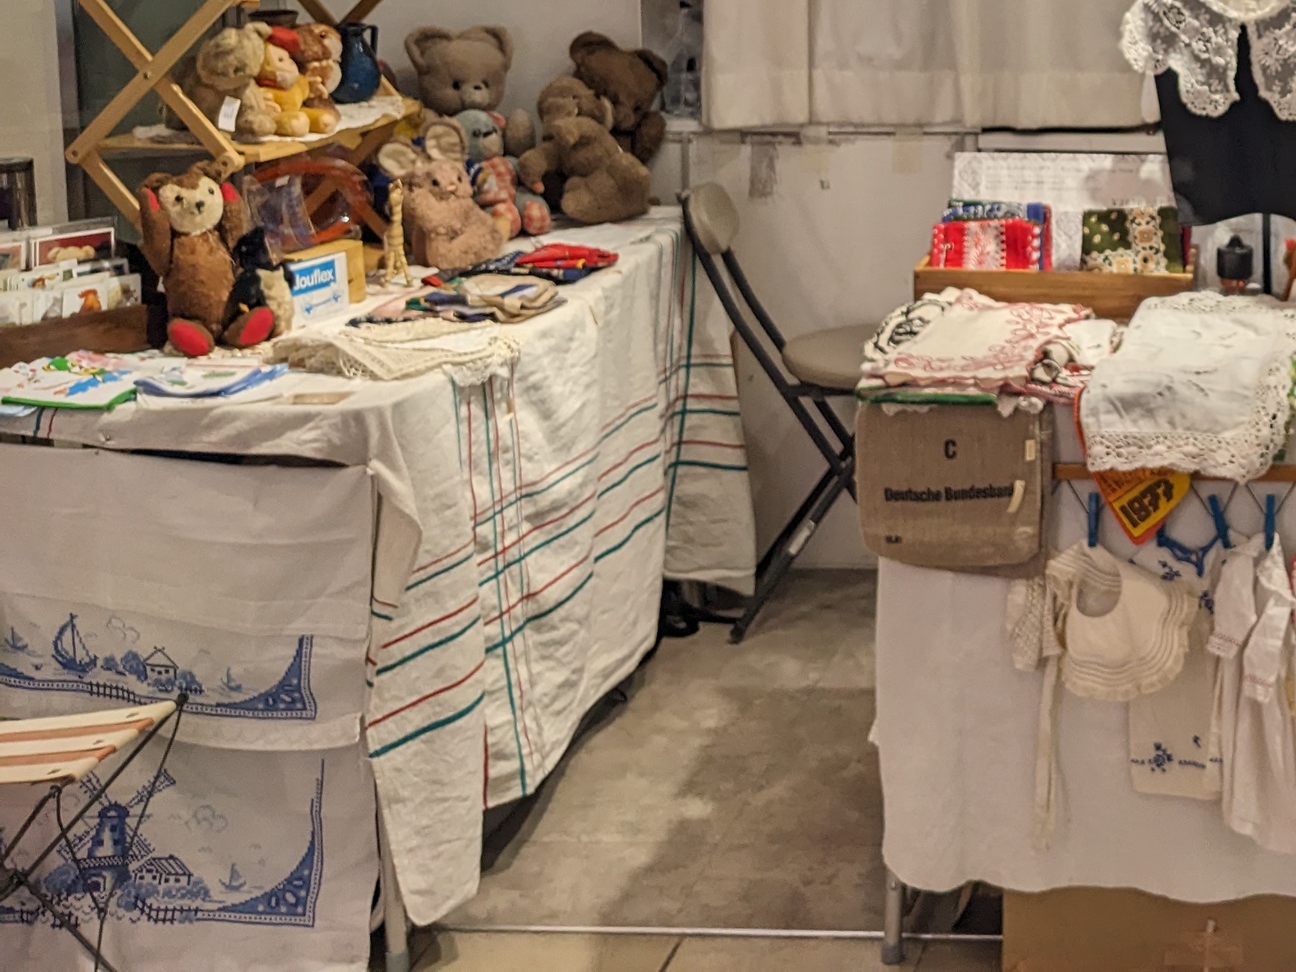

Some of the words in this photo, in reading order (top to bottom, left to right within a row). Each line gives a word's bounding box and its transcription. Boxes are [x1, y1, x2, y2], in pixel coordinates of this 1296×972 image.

[293, 268, 335, 291] Jouflex
[944, 438, 957, 459] C
[884, 486, 942, 502] Deutsche
[944, 482, 1014, 502] Bundesban
[1119, 478, 1174, 528] 1877
